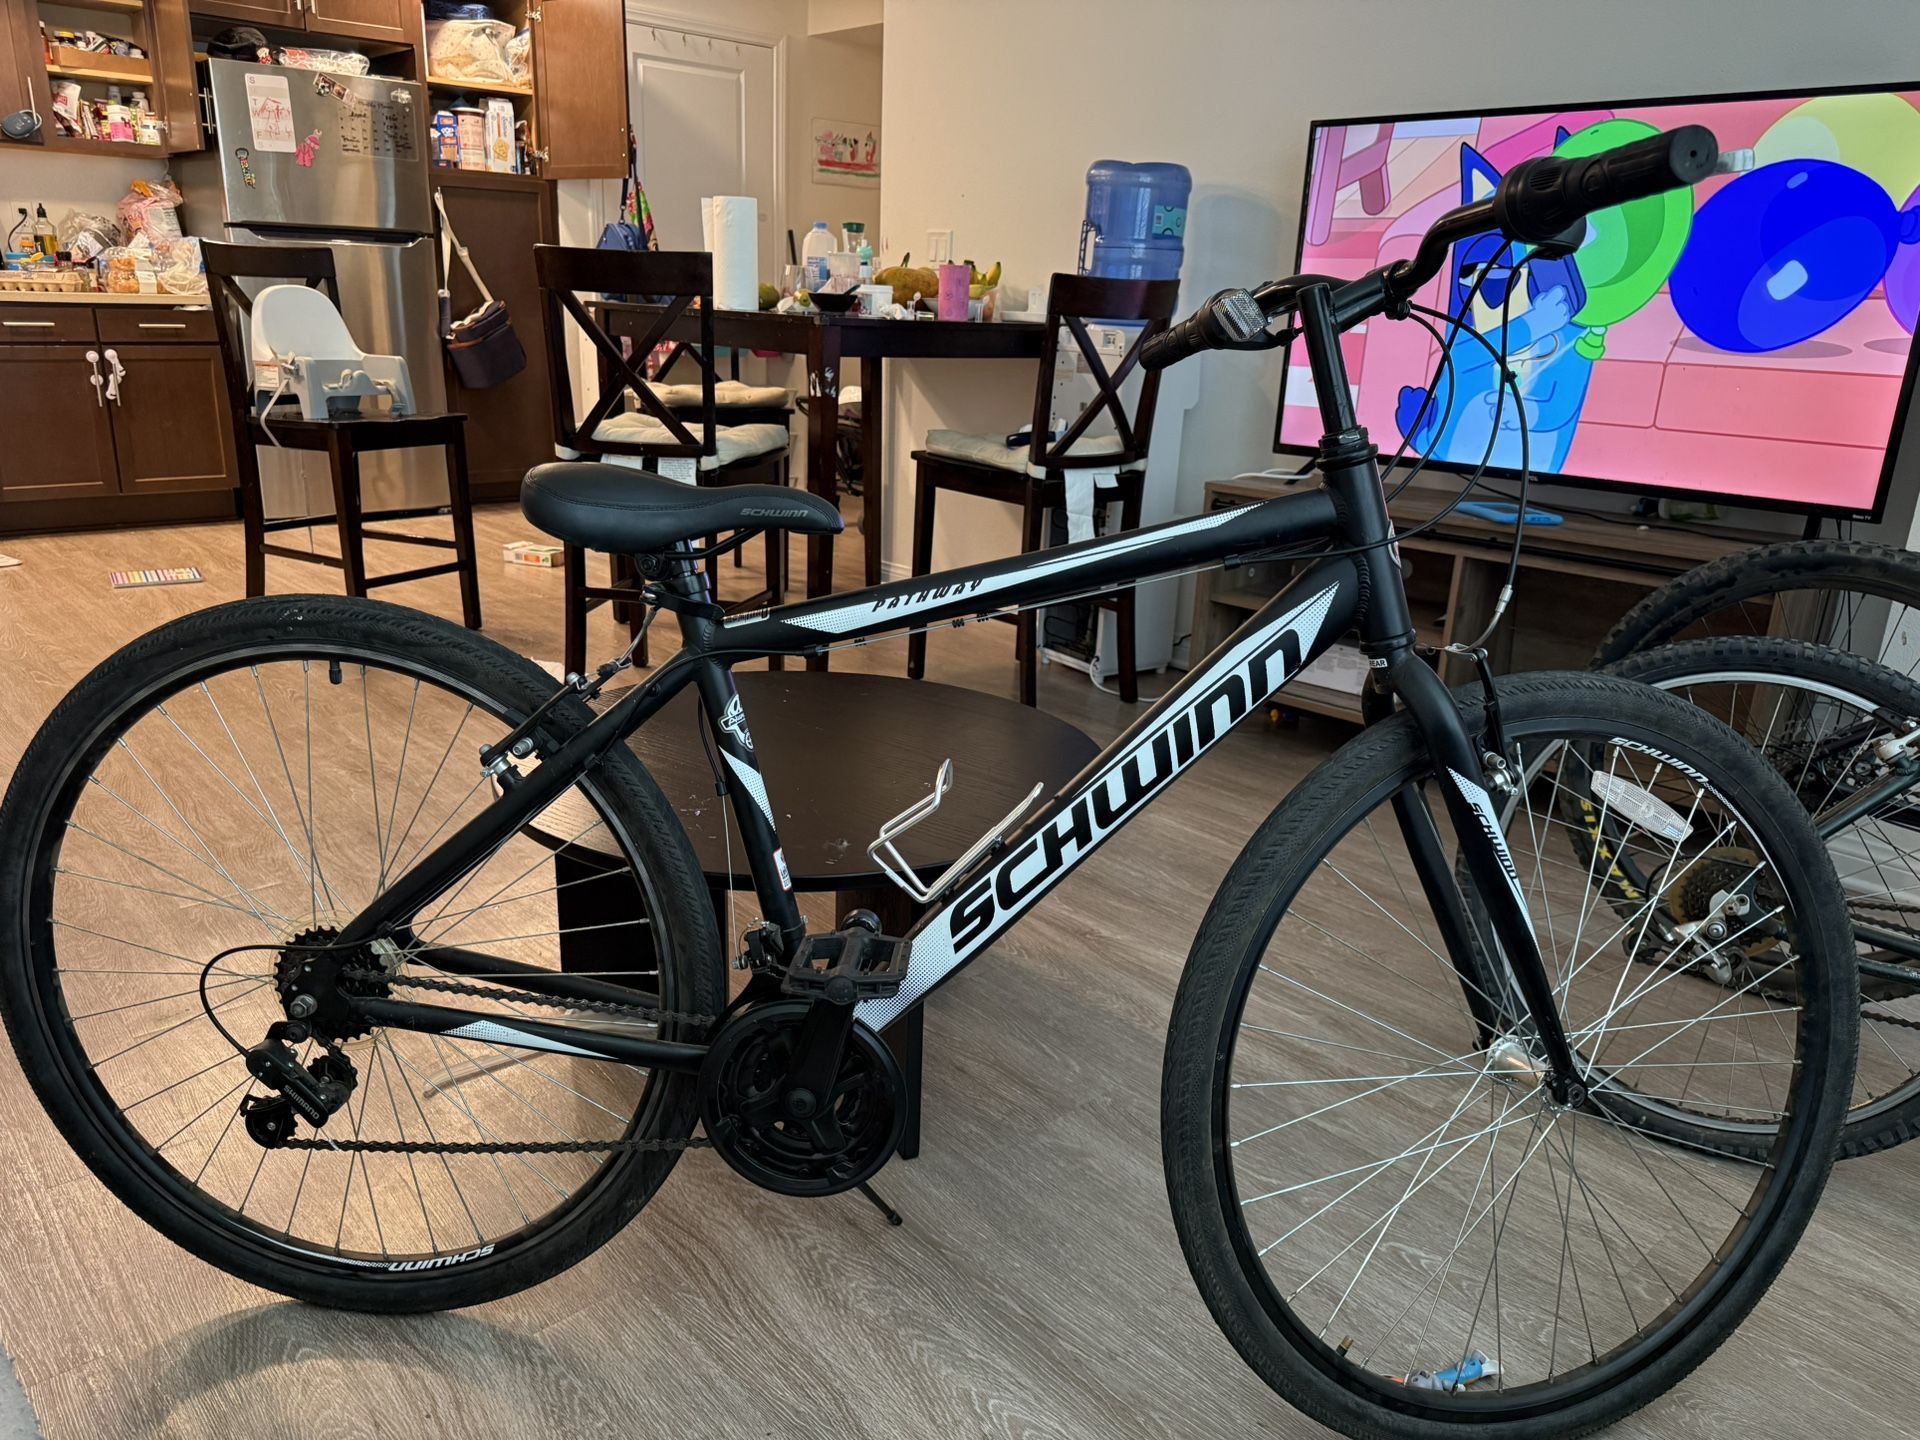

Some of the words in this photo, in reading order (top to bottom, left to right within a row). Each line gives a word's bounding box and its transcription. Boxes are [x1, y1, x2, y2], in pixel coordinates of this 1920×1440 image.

[740, 508, 808, 517] SCHWINN
[871, 579, 983, 612] PATHWAY
[1608, 737, 1709, 783] SCHWINN
[950, 628, 1301, 954] SCHWINN
[1471, 802, 1518, 880] SCHWINN
[1580, 799, 1641, 898] MAXXIS
[283, 1084, 320, 1120] SHIMANO
[388, 1243, 496, 1272] SCHWINN
